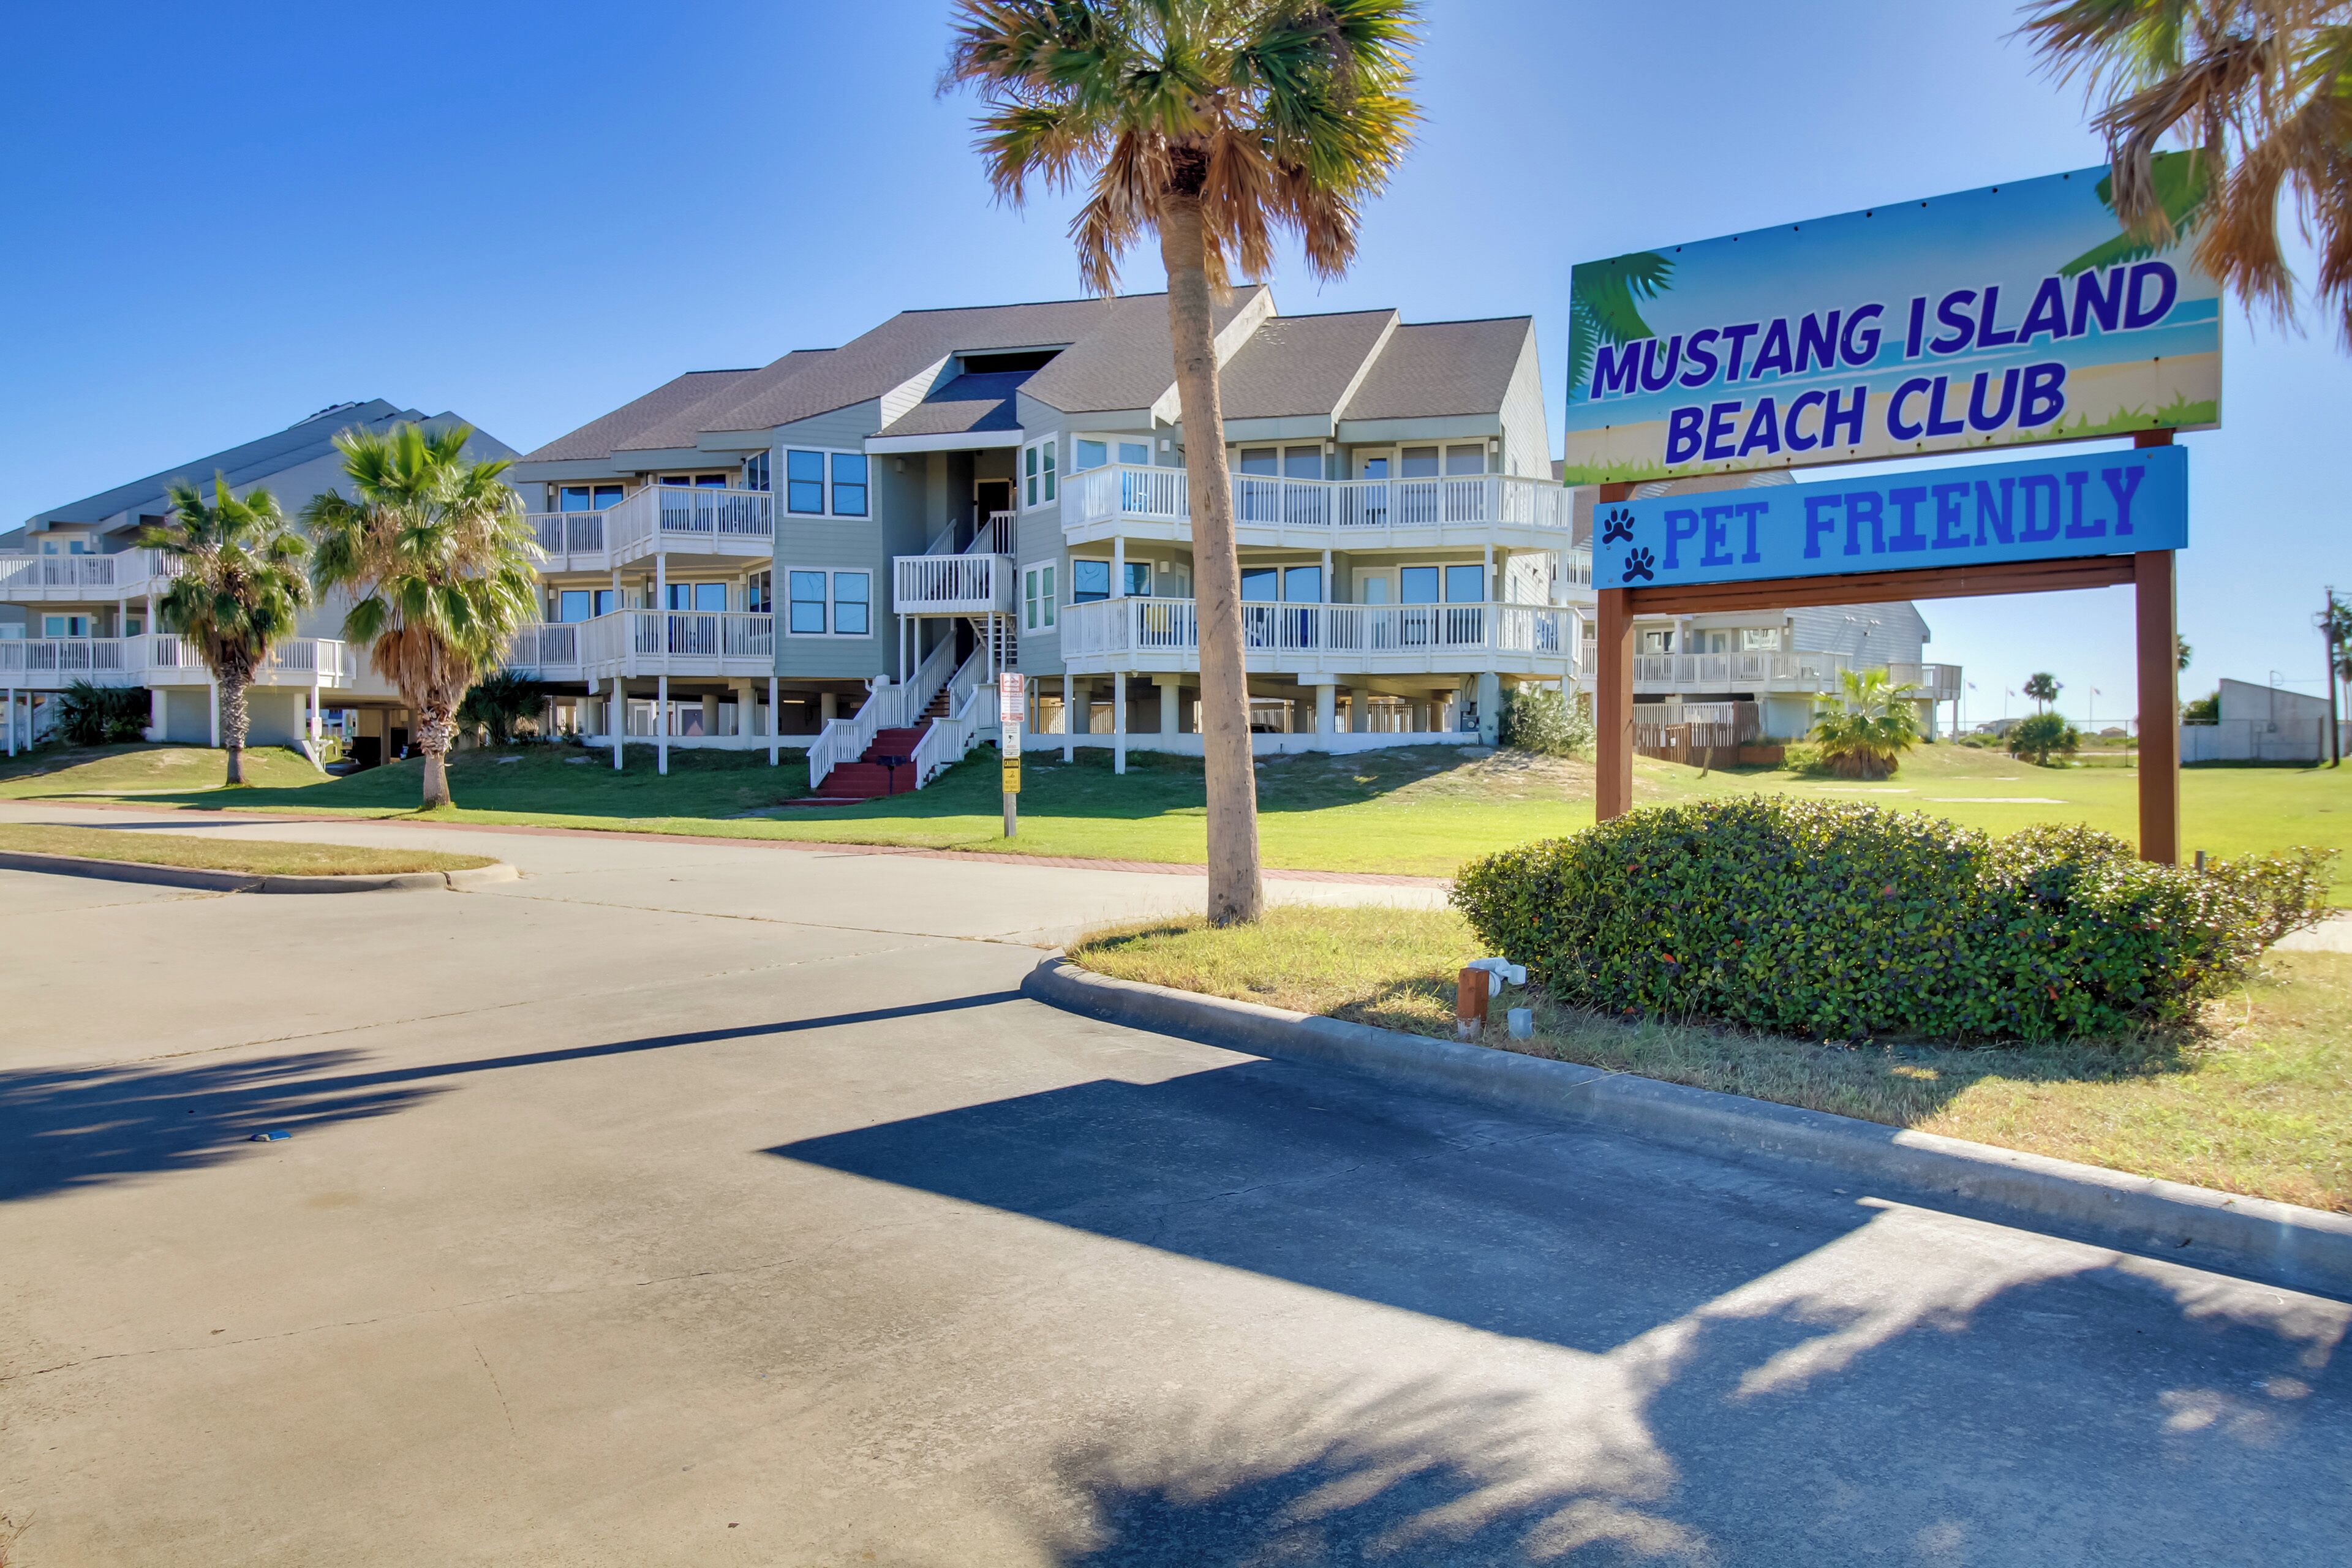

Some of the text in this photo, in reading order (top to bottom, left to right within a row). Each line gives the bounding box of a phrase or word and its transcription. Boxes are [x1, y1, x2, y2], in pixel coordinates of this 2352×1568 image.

[1591, 261, 2177, 399] MUSTANG ISLAND
[1665, 362, 2066, 464] BEACH CLUB
[1662, 464, 2147, 570] PET FRIENDLY
